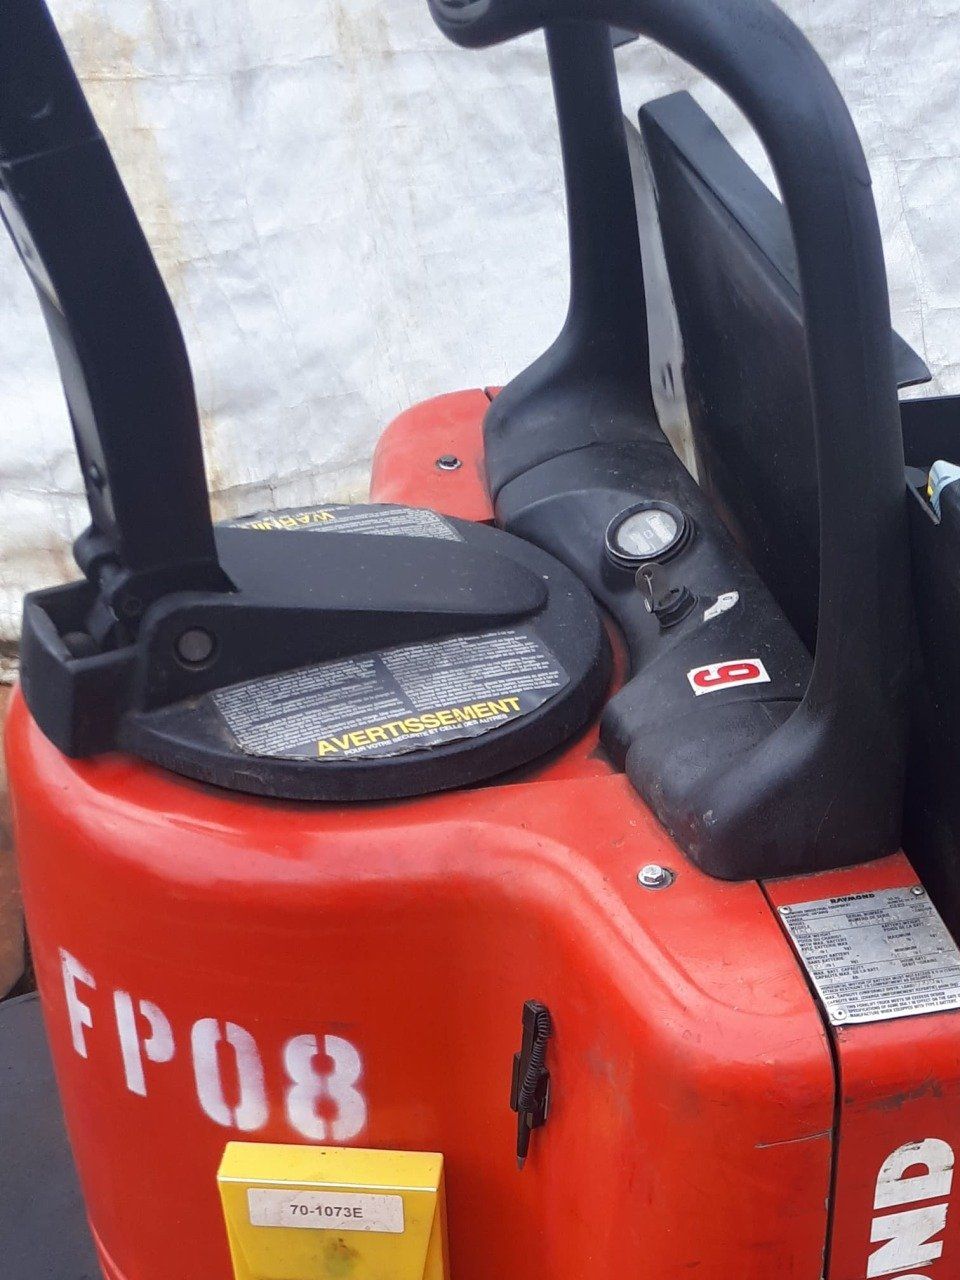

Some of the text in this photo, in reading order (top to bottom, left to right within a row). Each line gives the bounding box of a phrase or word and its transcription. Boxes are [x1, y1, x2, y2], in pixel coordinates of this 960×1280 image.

[317, 697, 521, 756] AVERTISSEMENT
[344, 745, 367, 757] POUR
[367, 740, 390, 751] VOTRE
[829, 893, 875, 903] RAYMOND
[58, 947, 368, 1142] FP08
[290, 1204, 363, 1219] 70-1073E
